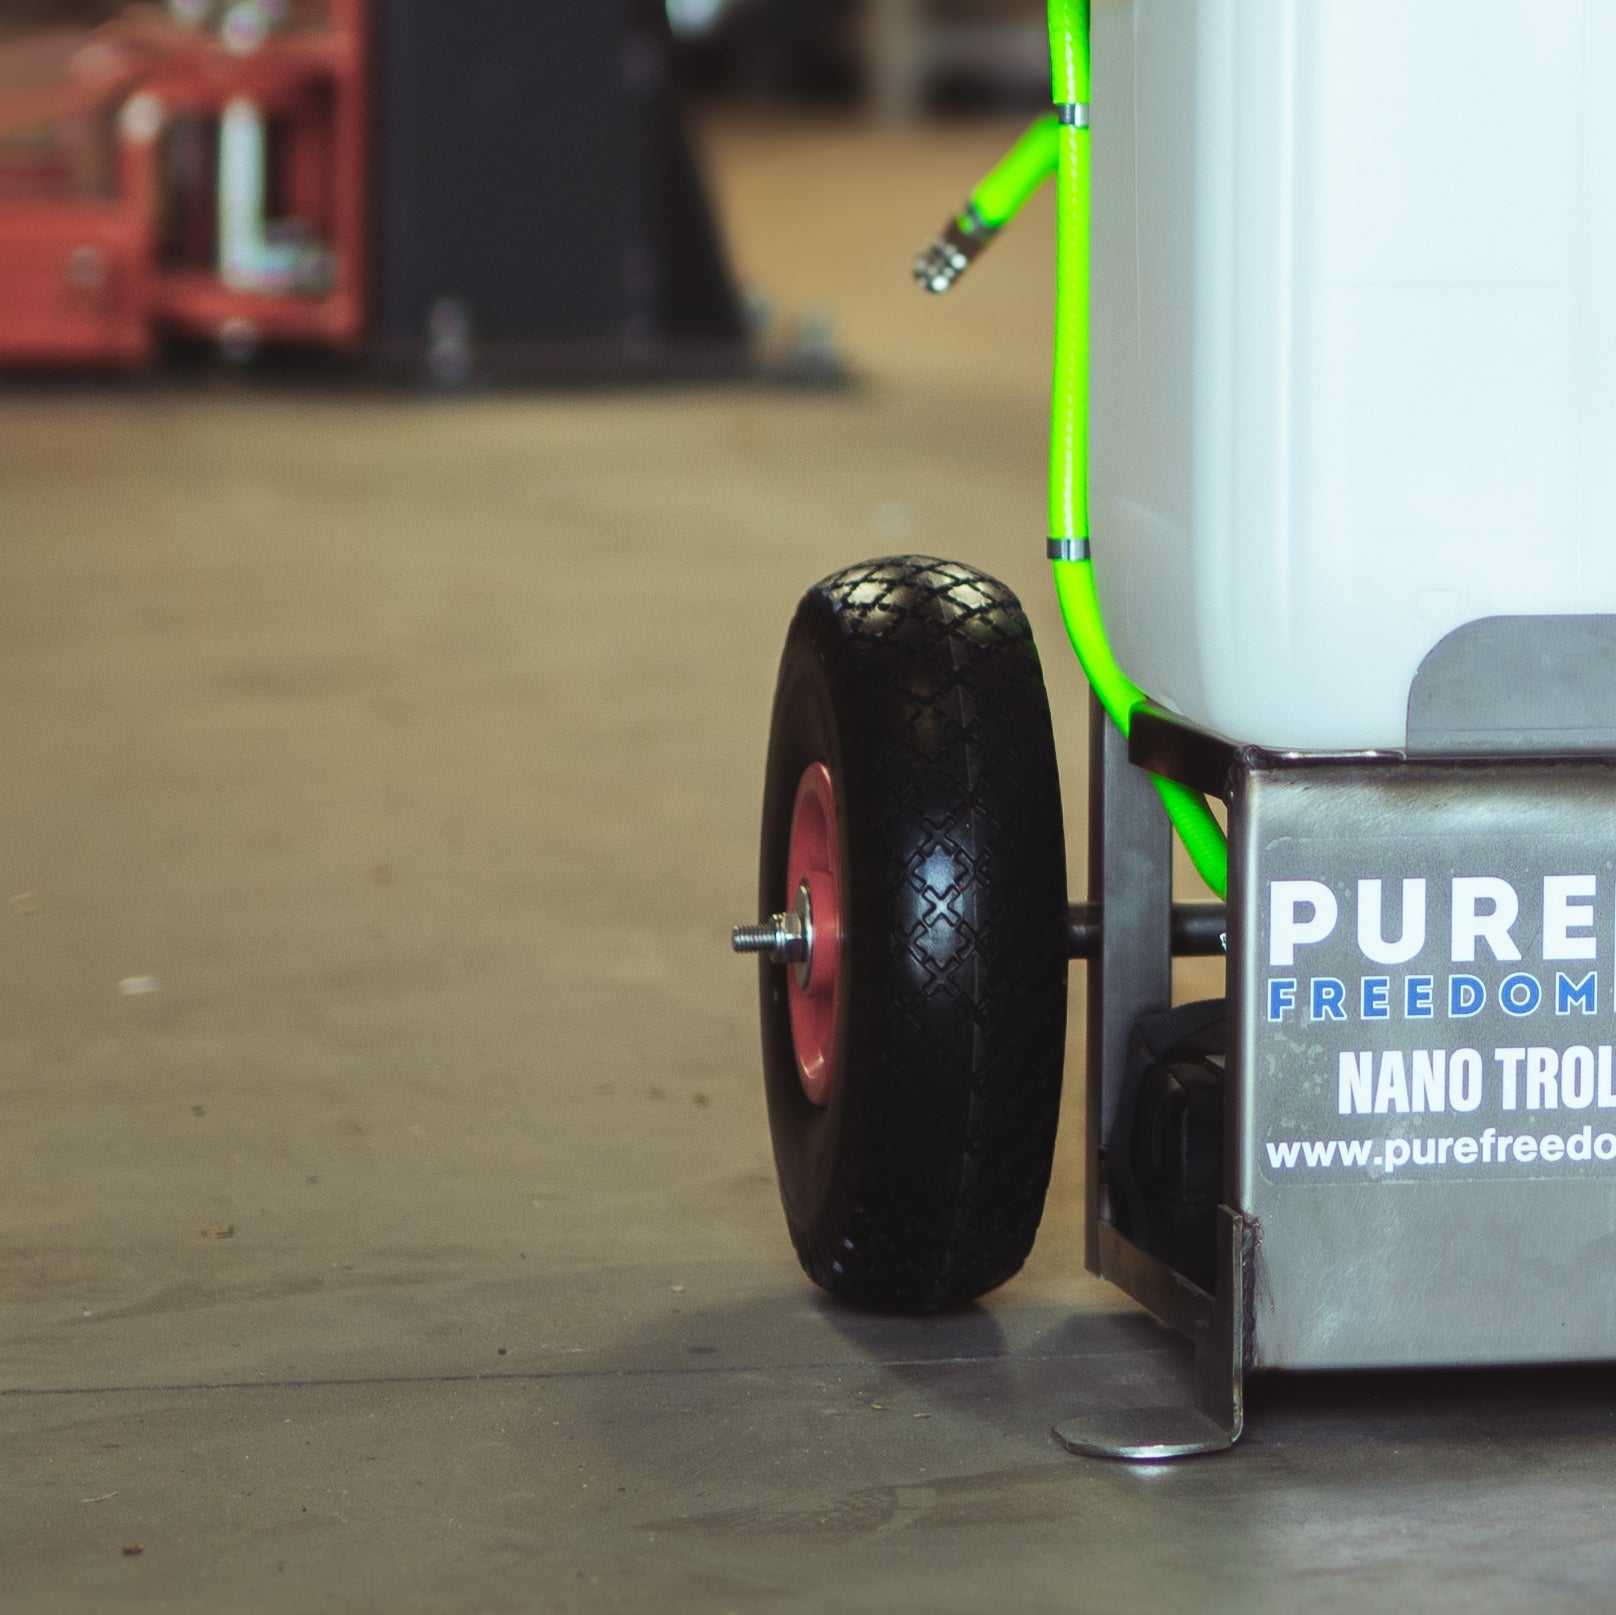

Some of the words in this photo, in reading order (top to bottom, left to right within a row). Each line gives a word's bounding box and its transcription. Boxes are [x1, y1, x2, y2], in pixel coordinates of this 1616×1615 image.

[1269, 874, 1597, 967] PURE
[1267, 971, 1598, 1022] FREEDOM
[1338, 1049, 1483, 1115] NANO
